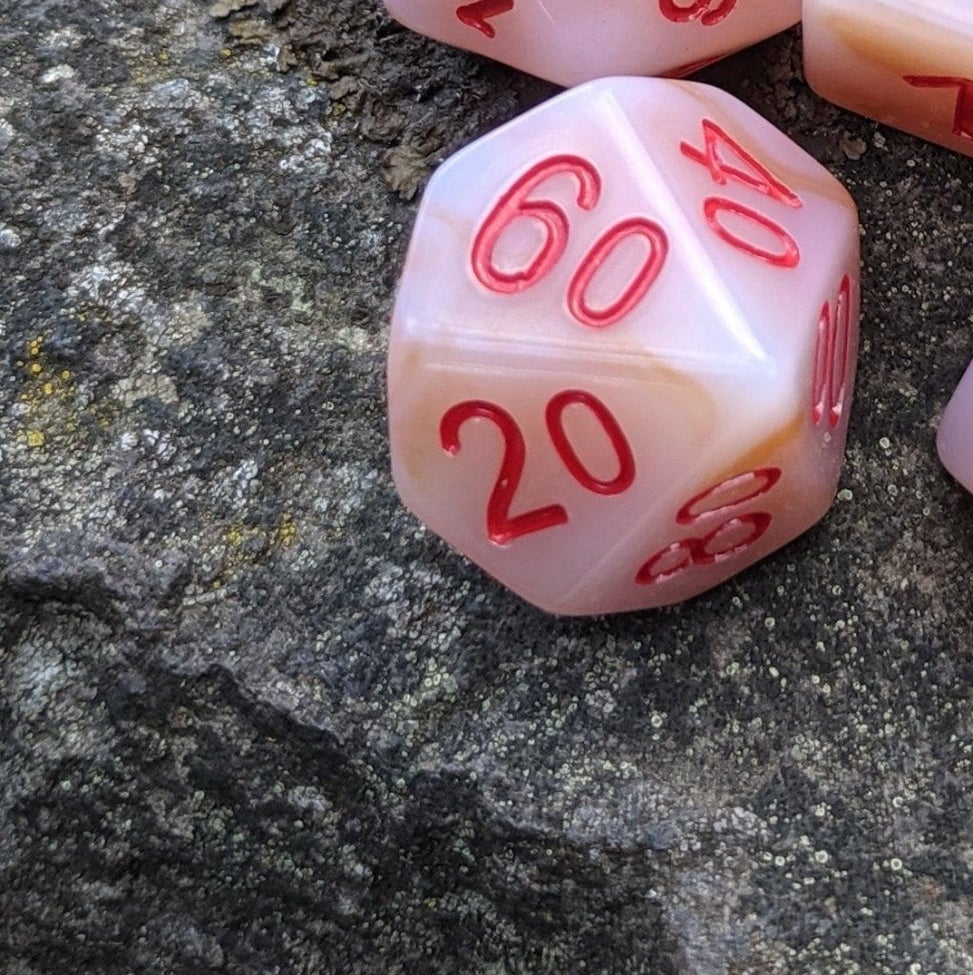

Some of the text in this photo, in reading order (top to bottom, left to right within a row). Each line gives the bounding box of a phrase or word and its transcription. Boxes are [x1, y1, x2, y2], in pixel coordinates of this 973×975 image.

[471, 154, 669, 328] 60
[679, 118, 803, 268] 40
[440, 389, 636, 546] 20
[635, 466, 782, 585] 80
